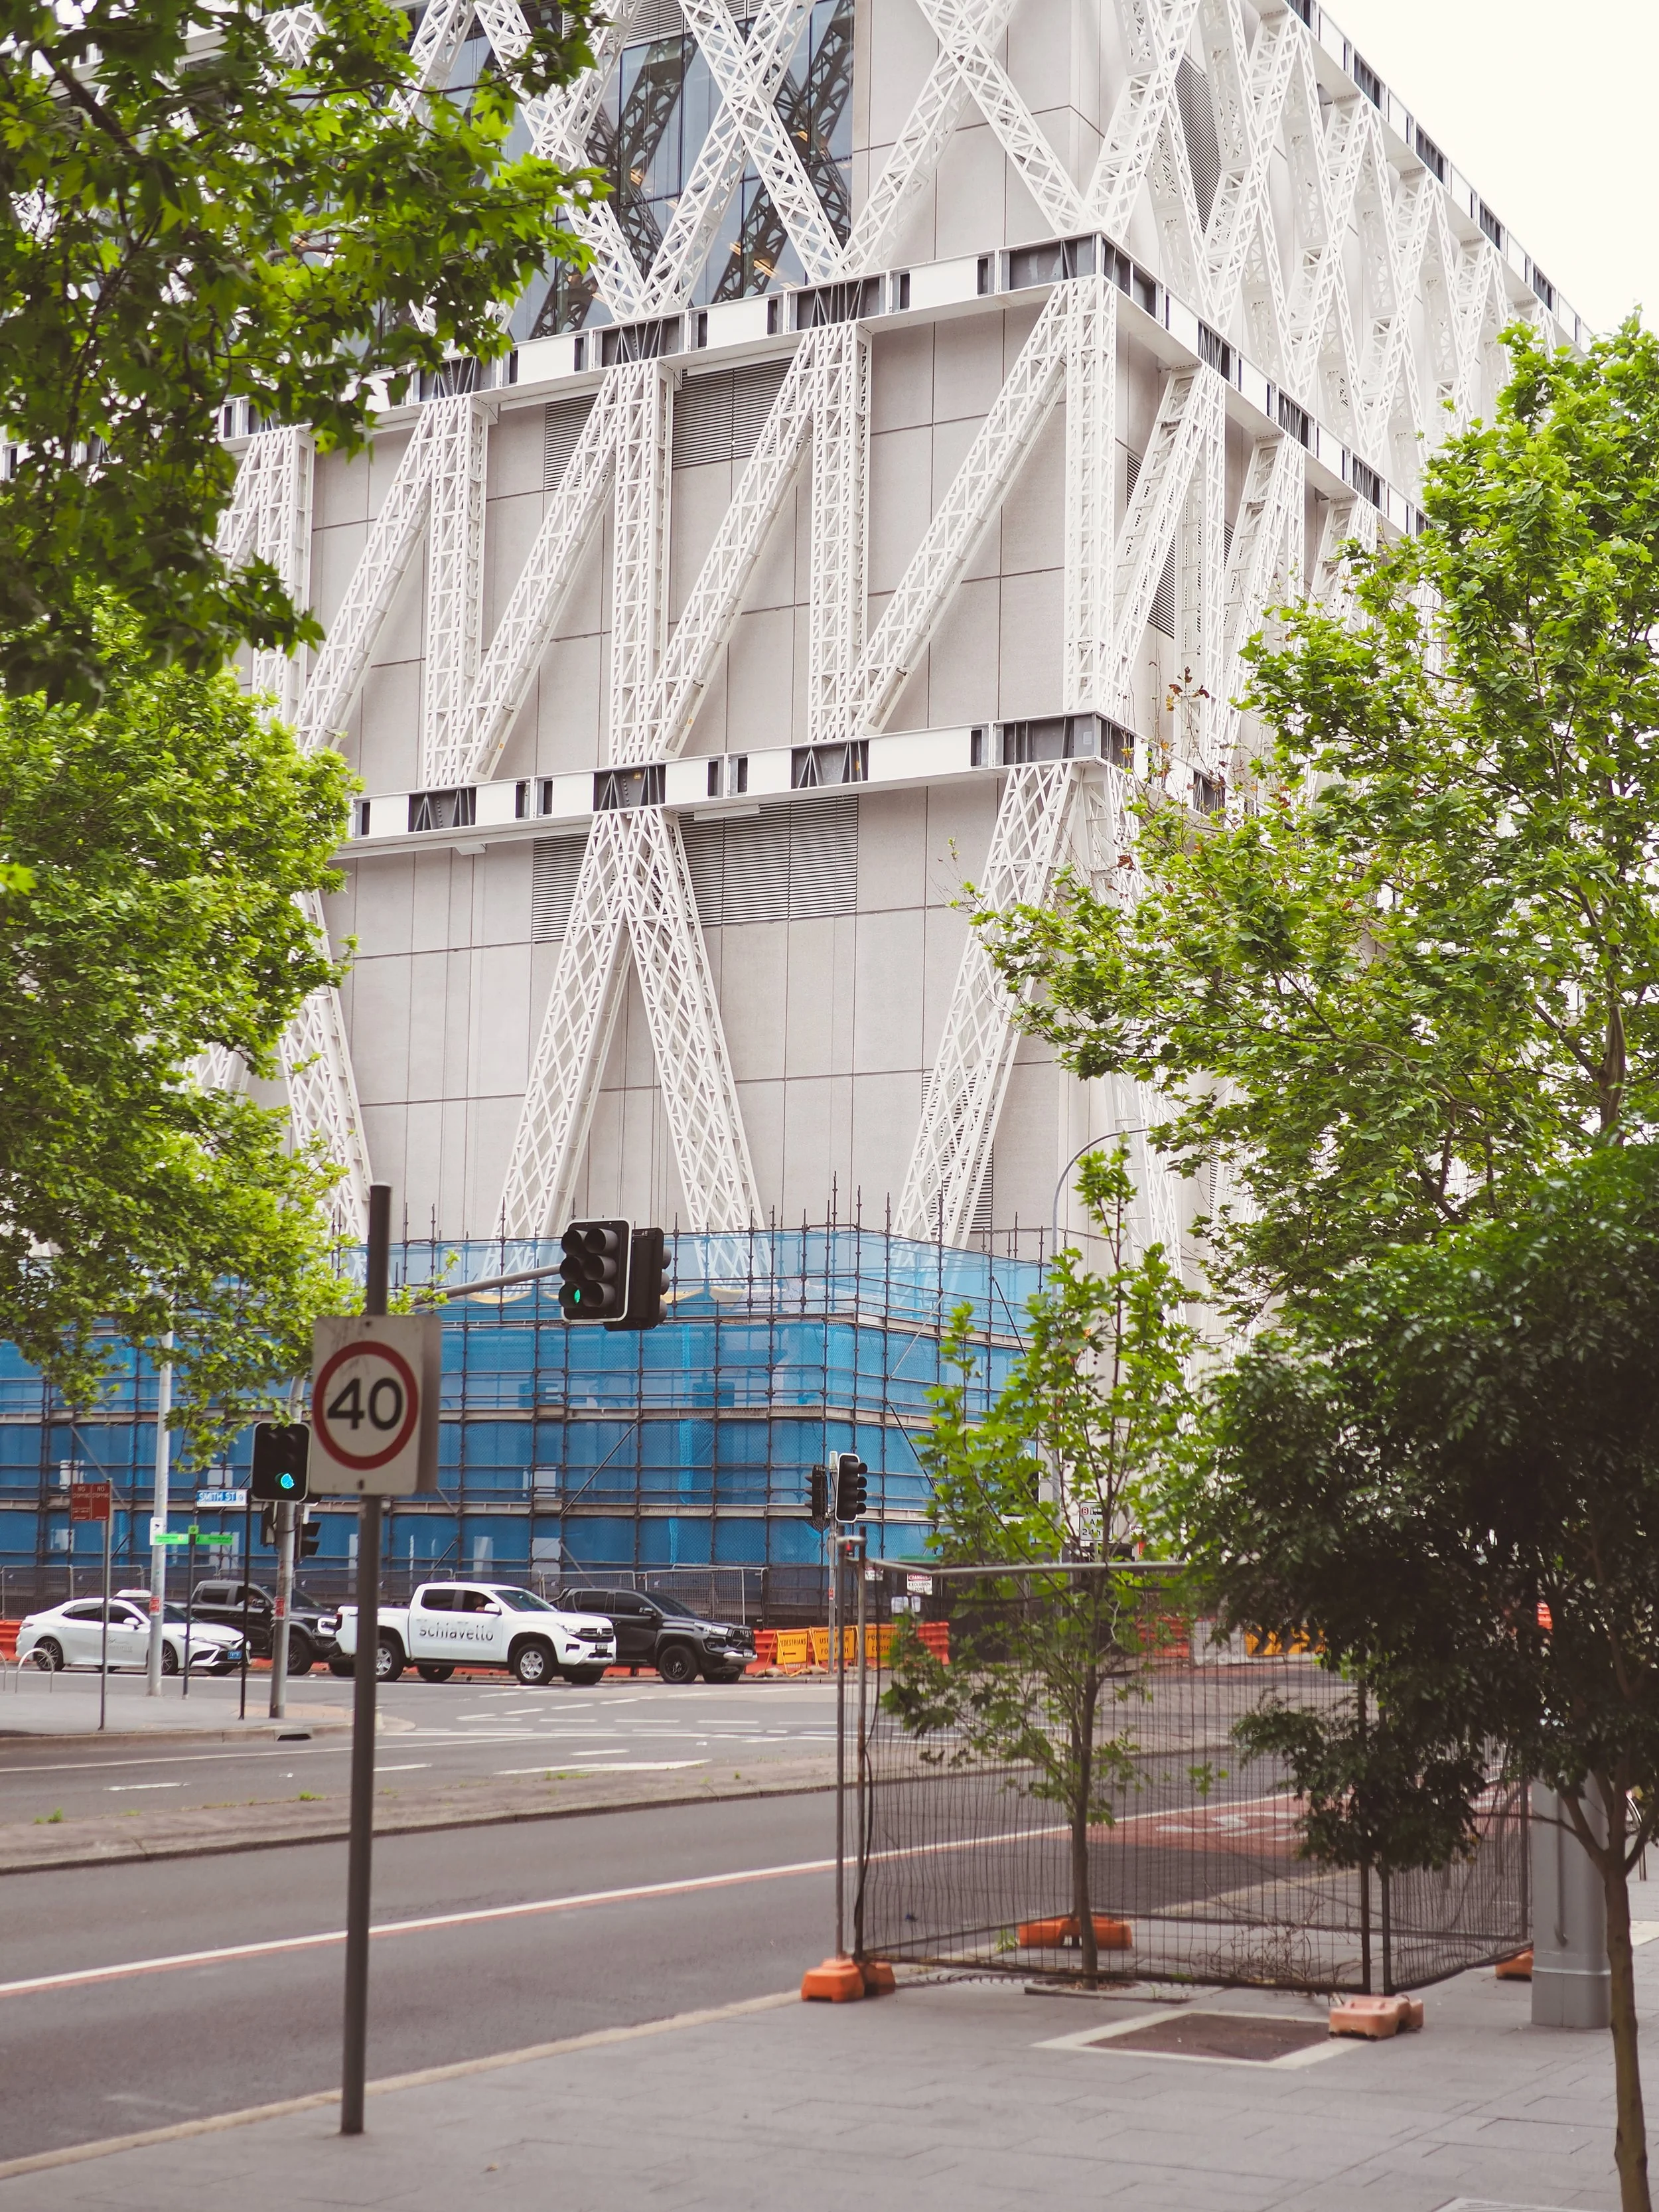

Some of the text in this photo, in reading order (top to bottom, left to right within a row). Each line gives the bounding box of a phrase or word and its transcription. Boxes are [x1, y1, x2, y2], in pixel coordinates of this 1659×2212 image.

[327, 1377, 402, 1430] 40
[198, 1492, 236, 1502] SMITH ST
